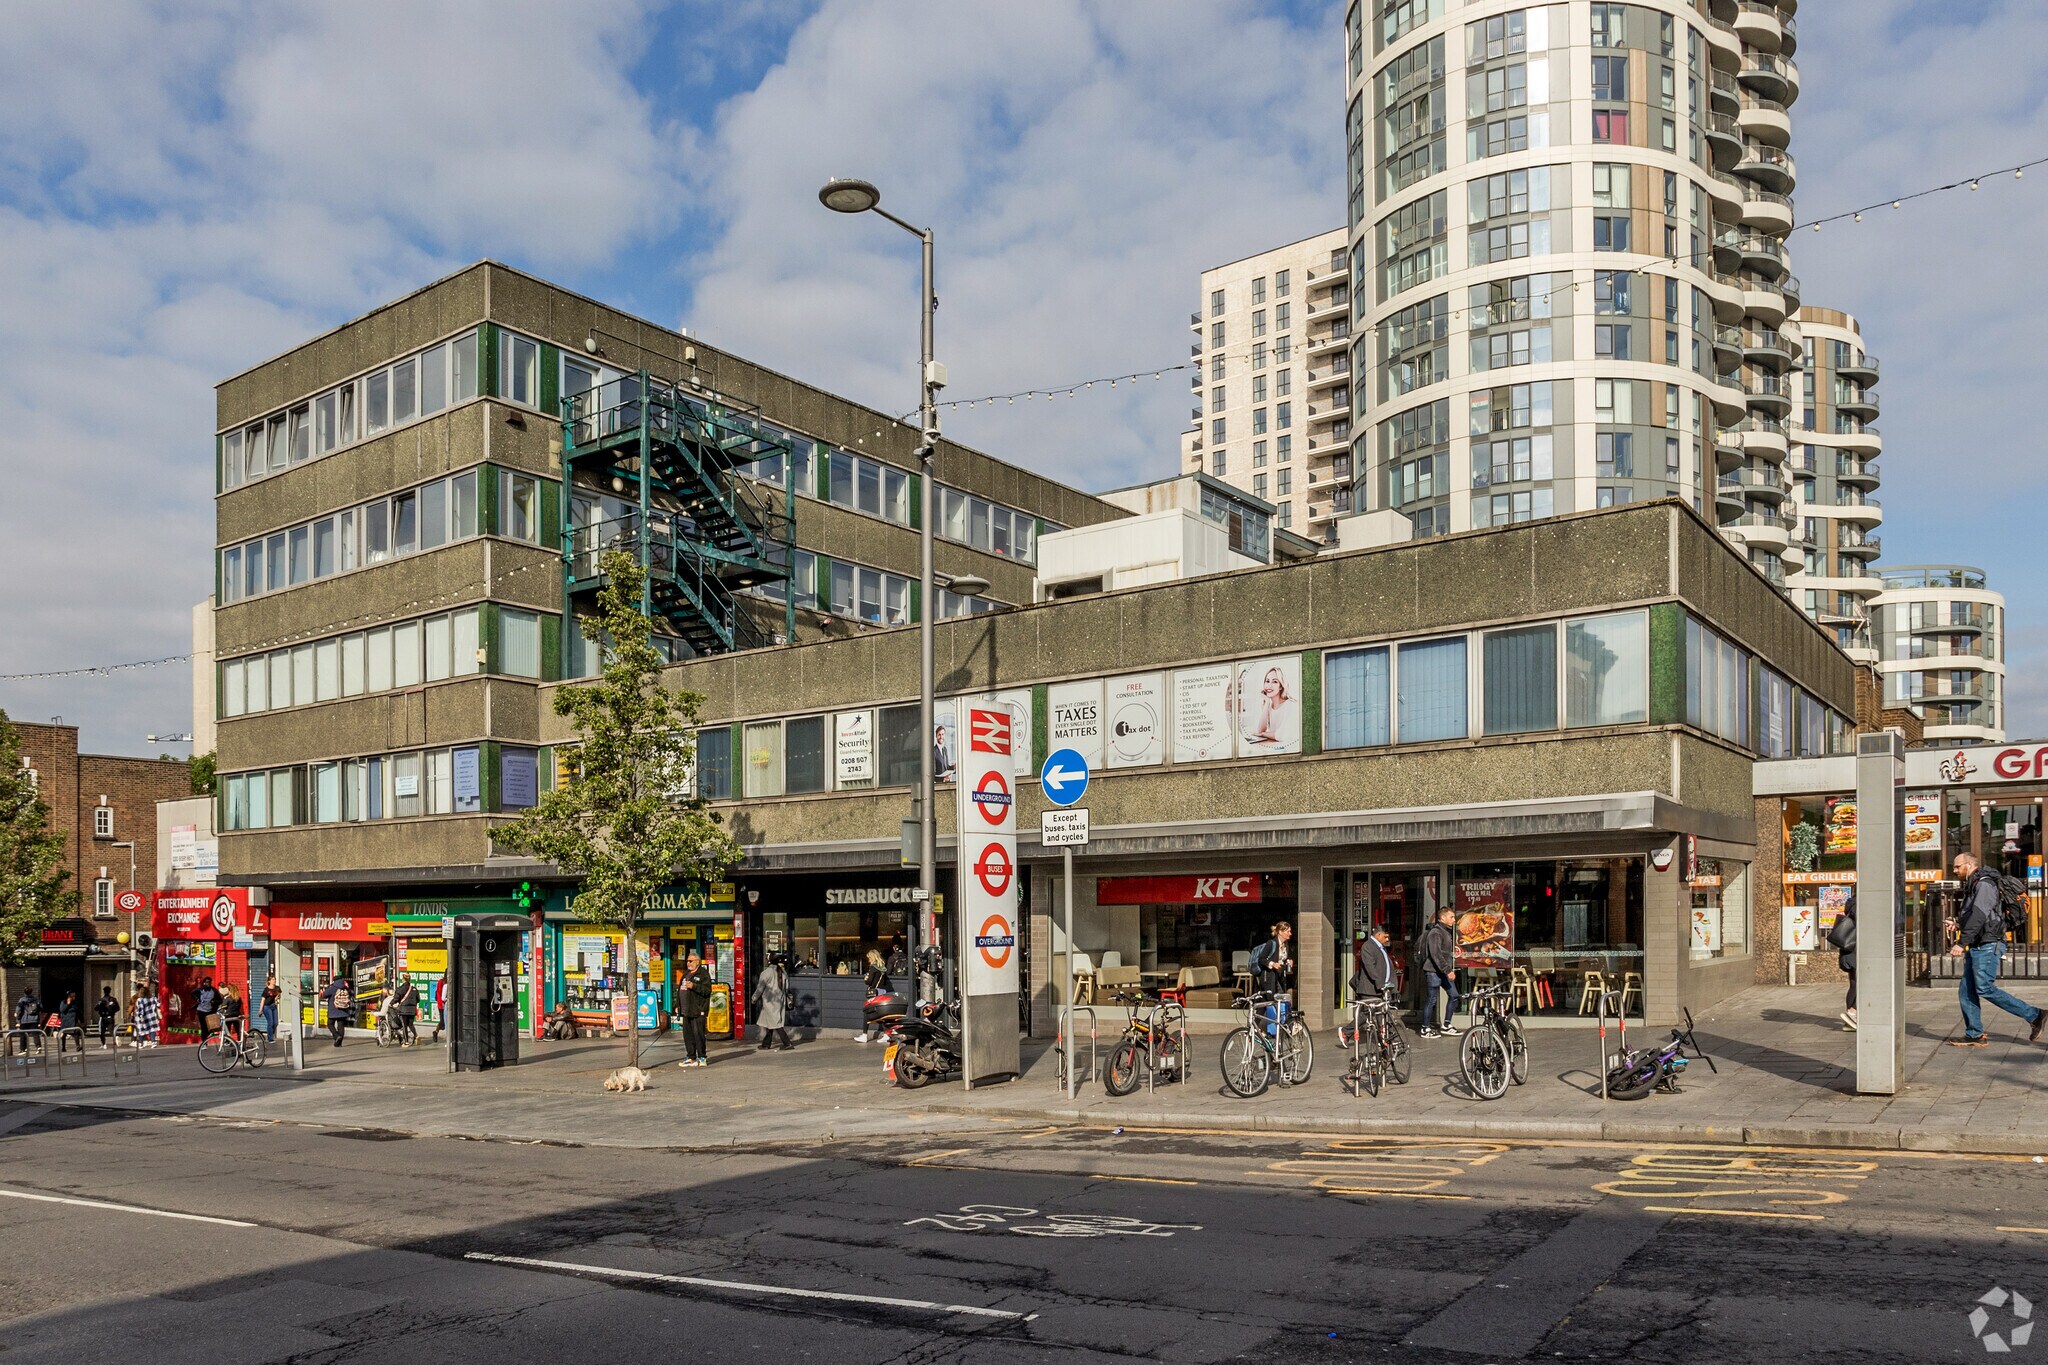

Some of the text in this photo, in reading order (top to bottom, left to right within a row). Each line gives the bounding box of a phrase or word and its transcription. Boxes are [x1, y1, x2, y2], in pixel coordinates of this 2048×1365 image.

[1126, 682, 1142, 691] FREE
[1115, 689, 1154, 699] CONSULTATION
[1055, 706, 1097, 723] TAXES
[1139, 725, 1151, 733] dot
[1182, 720, 1213, 728] BOOKKEEPING
[1055, 726, 1098, 739] MATTERS
[838, 737, 870, 749] Security
[973, 793, 1012, 804] UNDERGROUND
[1053, 814, 1077, 824] Except
[1068, 822, 1086, 831] taxis
[1046, 832, 1084, 842] and cycles
[987, 865, 1003, 873] BUSES
[1787, 873, 1807, 882] EAT
[1194, 877, 1251, 898] KFC
[1460, 882, 1496, 891] TRILOGY
[158, 897, 210, 909] ENTERTAINMENT
[413, 902, 448, 916] LONDIS
[168, 912, 200, 924] EXCHANGE
[253, 908, 264, 927] L
[298, 912, 353, 930] Ladbrokes
[979, 937, 1013, 946] OVERGROUND
